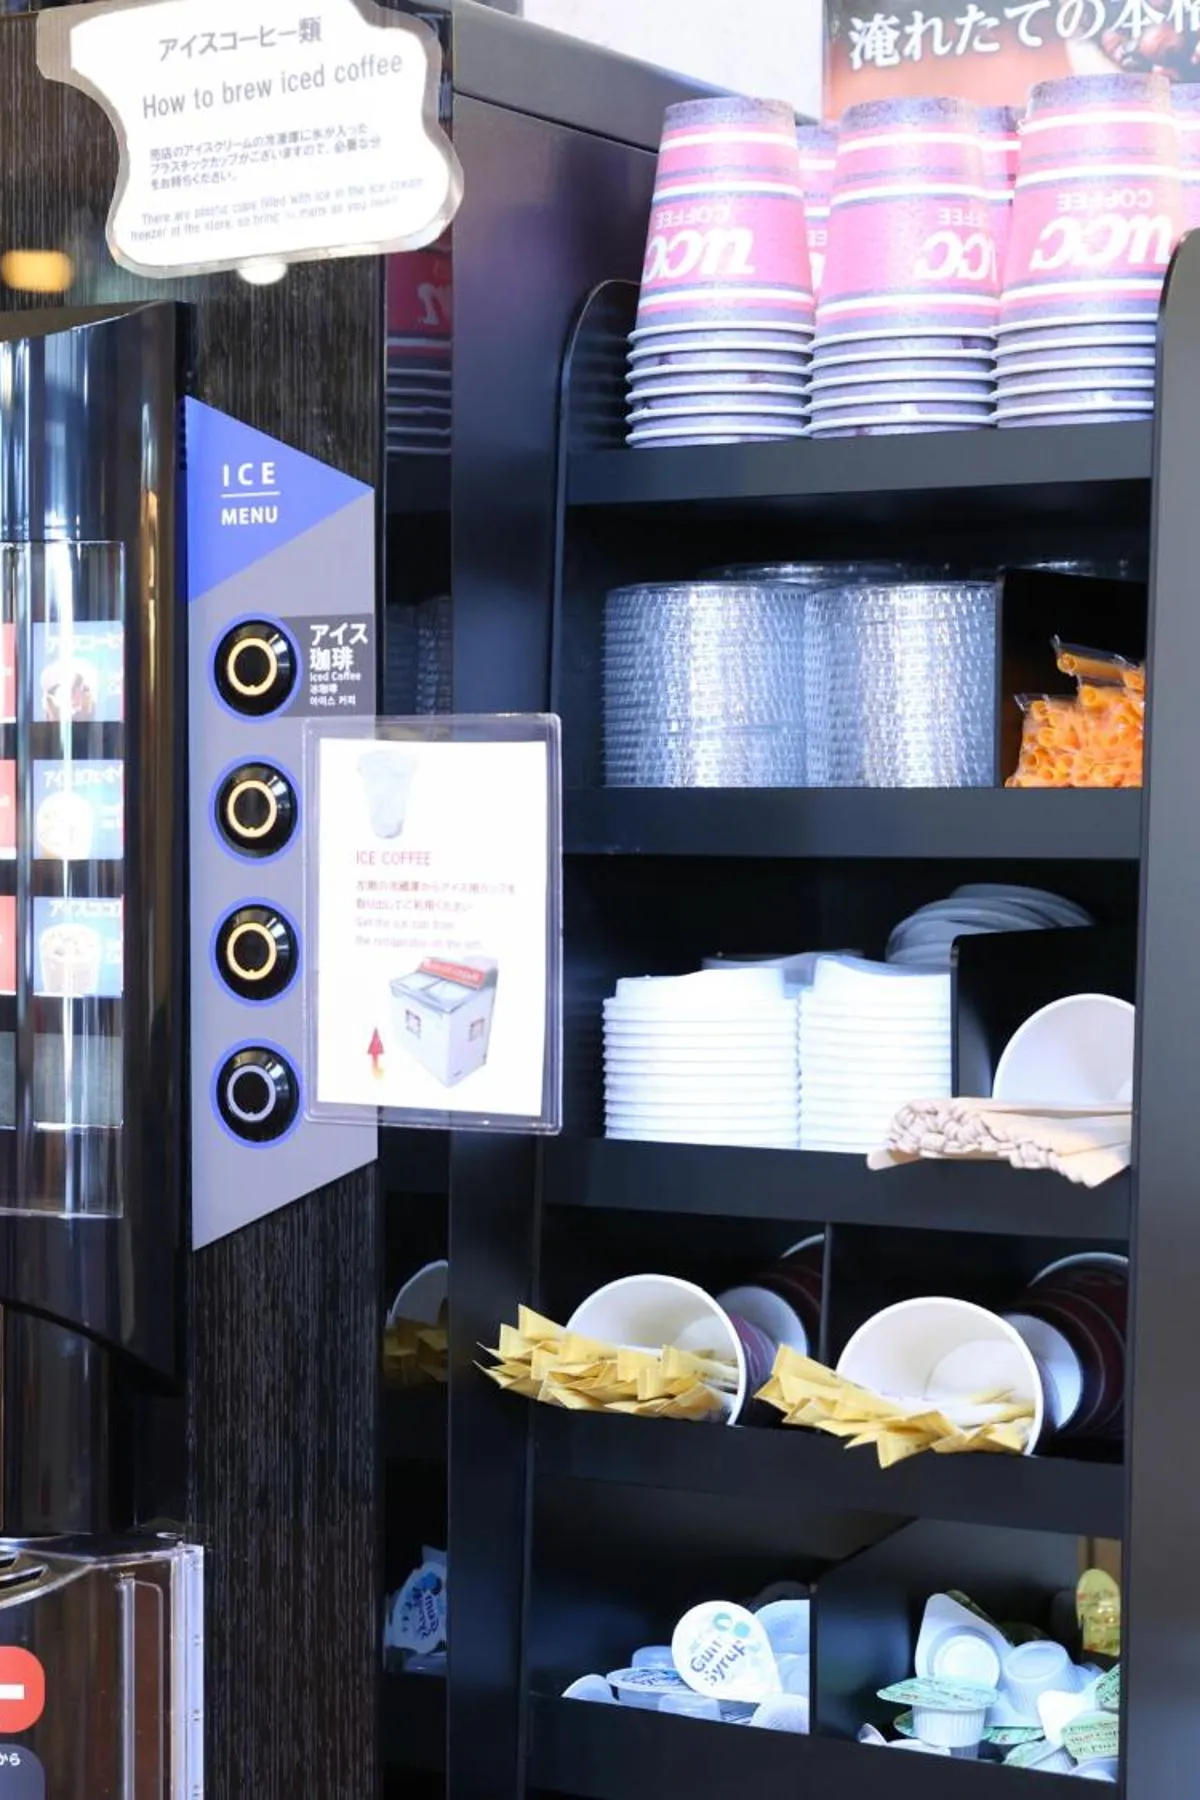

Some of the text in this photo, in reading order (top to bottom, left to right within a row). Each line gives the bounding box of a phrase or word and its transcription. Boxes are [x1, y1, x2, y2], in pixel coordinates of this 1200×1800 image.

[159, 17, 321, 61] アイスコーヒー類
[143, 54, 403, 119] How to brew iced coffee
[1057, 188, 1153, 211] COFFEE
[655, 204, 731, 230] COFFEE
[222, 462, 276, 487] ICE
[221, 505, 278, 526] MENU
[310, 622, 369, 646] アイス
[310, 646, 354, 671] 珈琲
[356, 849, 432, 867] ICE COFFEE
